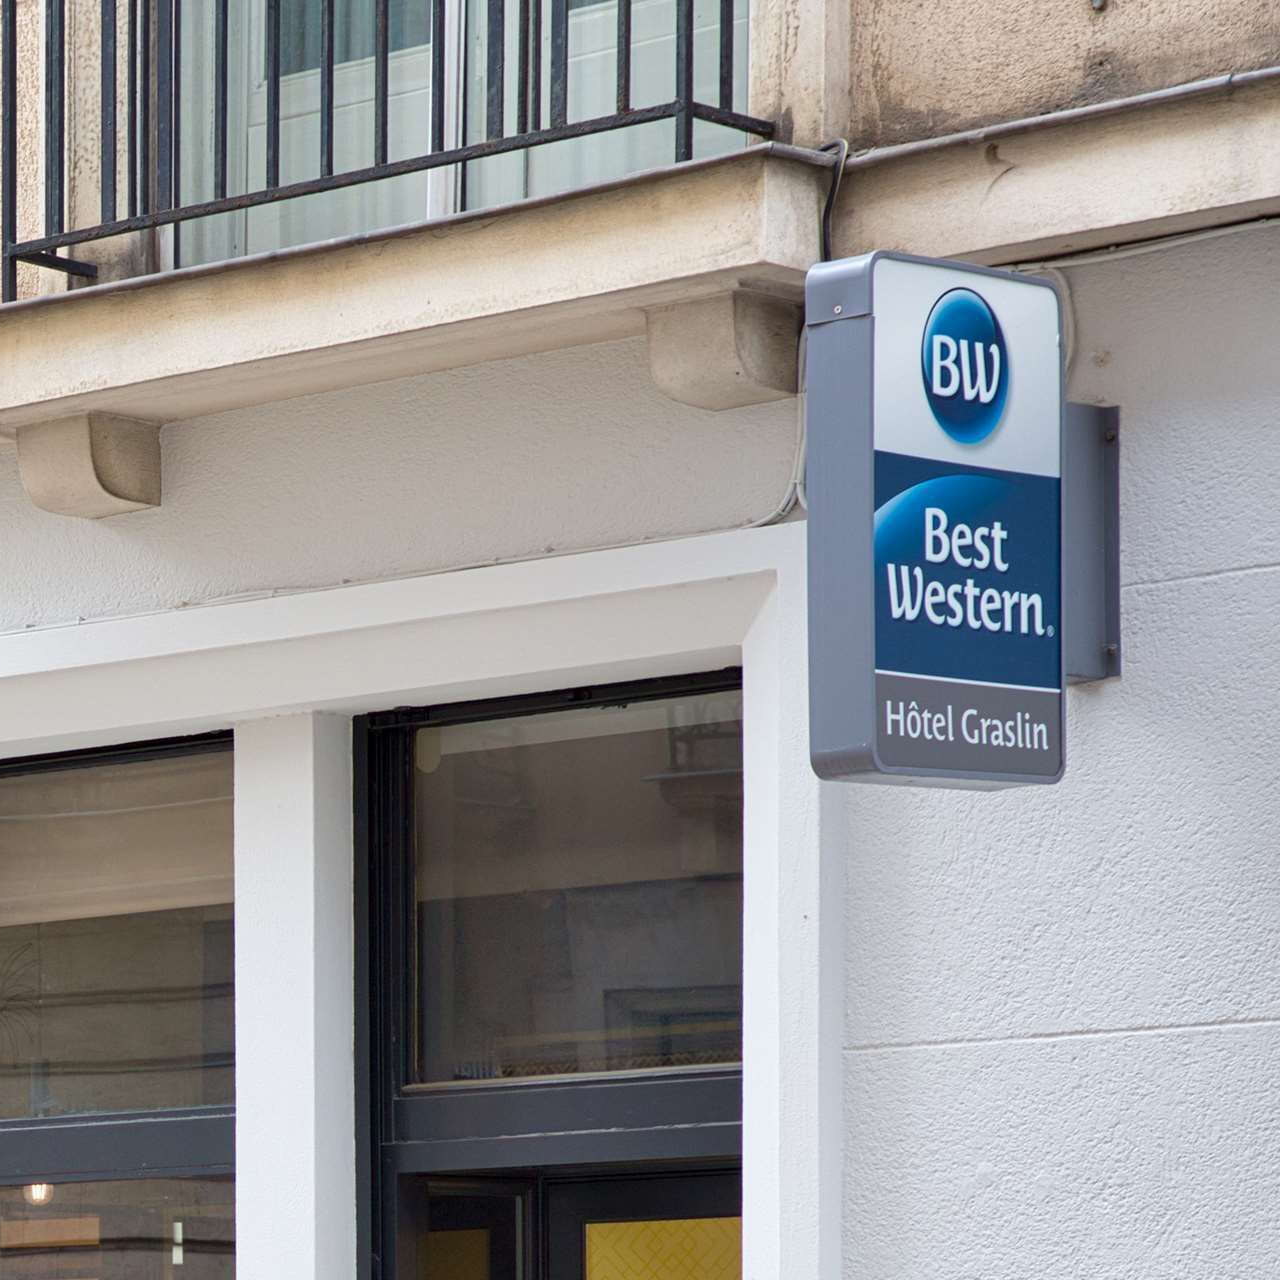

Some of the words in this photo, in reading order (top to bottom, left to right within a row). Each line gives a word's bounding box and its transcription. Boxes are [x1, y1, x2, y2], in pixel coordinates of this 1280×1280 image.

[932, 334, 1001, 404] BW
[924, 507, 1008, 573] Best
[885, 700, 954, 741] Hôtel
[961, 708, 1049, 751] Graslin
